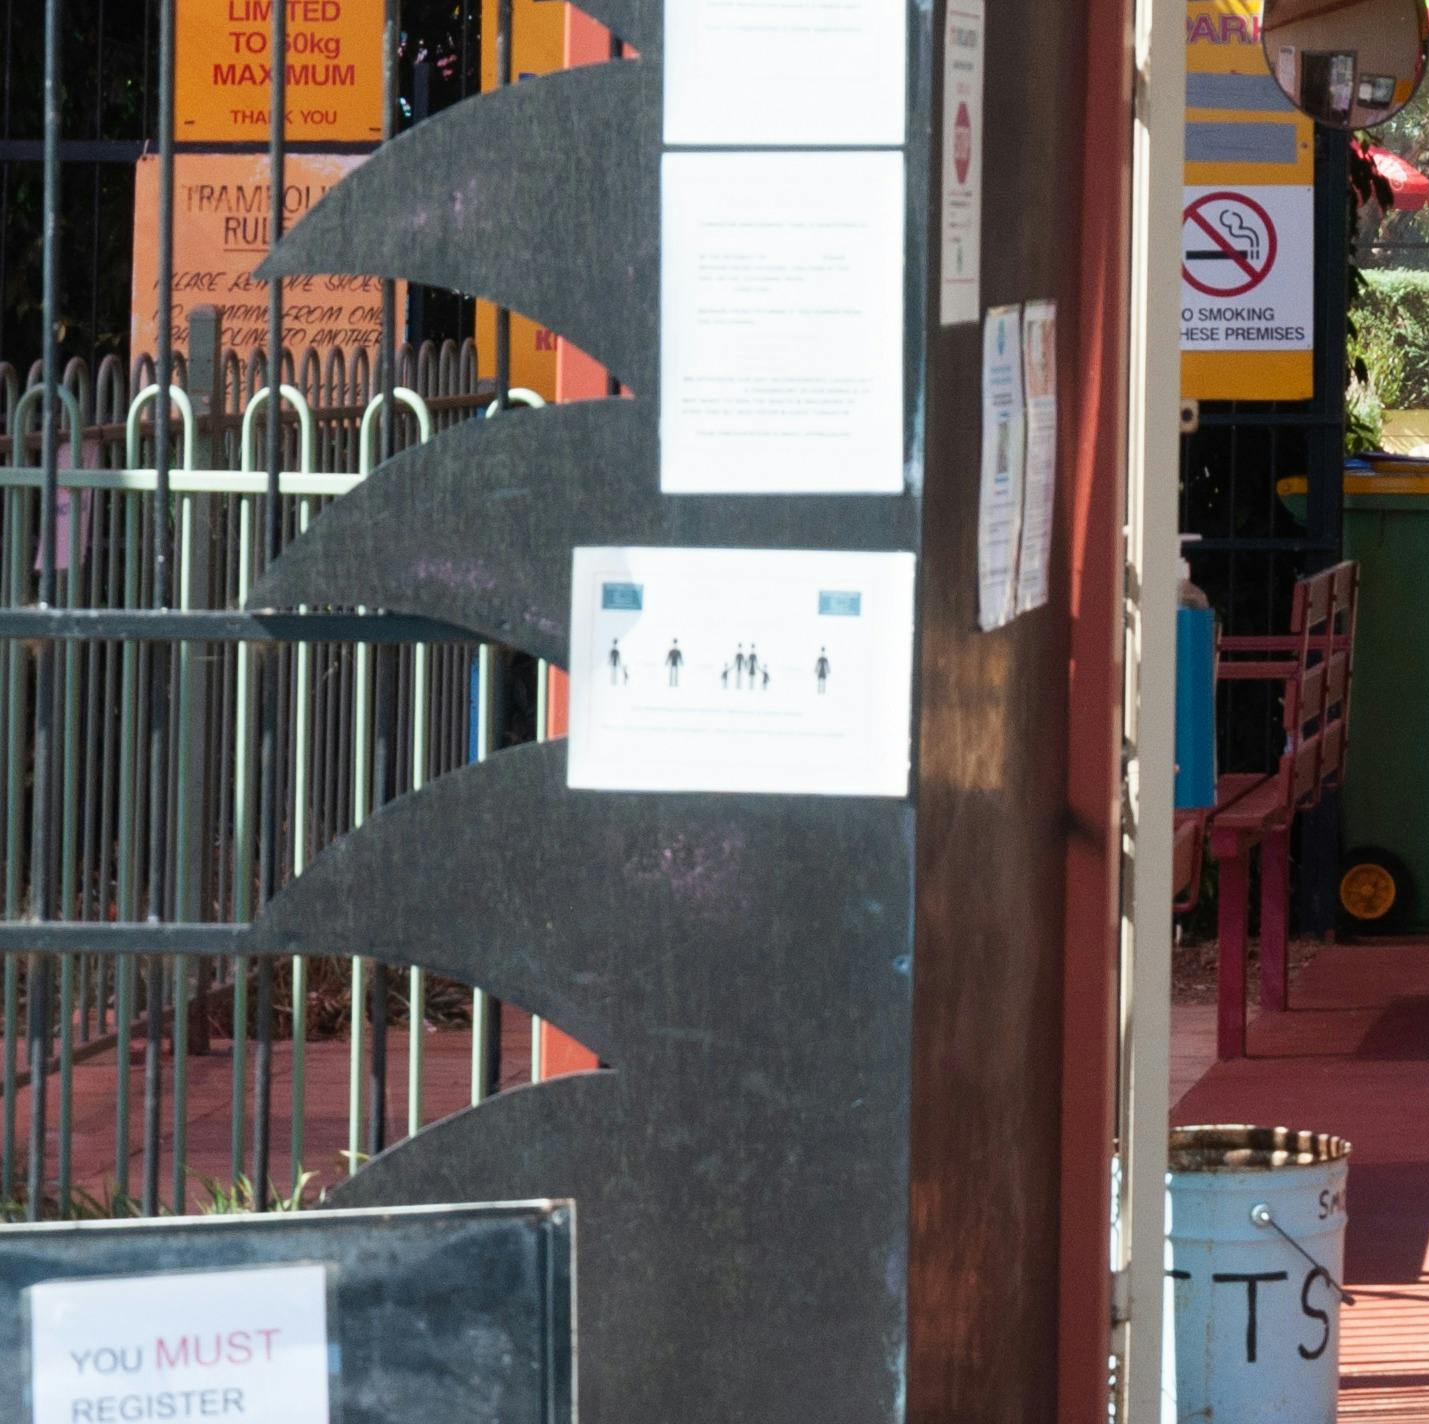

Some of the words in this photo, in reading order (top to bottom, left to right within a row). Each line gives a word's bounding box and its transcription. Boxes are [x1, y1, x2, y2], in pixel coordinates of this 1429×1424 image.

[228, 0, 340, 22] LIMTED
[228, 31, 267, 54] TO
[212, 63, 356, 86] MAXMUM
[230, 109, 293, 125] THAK
[300, 109, 338, 125] YOU
[282, 305, 343, 324] FROM
[1198, 307, 1275, 322] SMOKING
[1180, 327, 1220, 341] HESE
[1224, 326, 1305, 342] PREMISES
[69, 1346, 143, 1375] YOU
[154, 1328, 282, 1371] MUST
[71, 1387, 246, 1424] REGISTER
